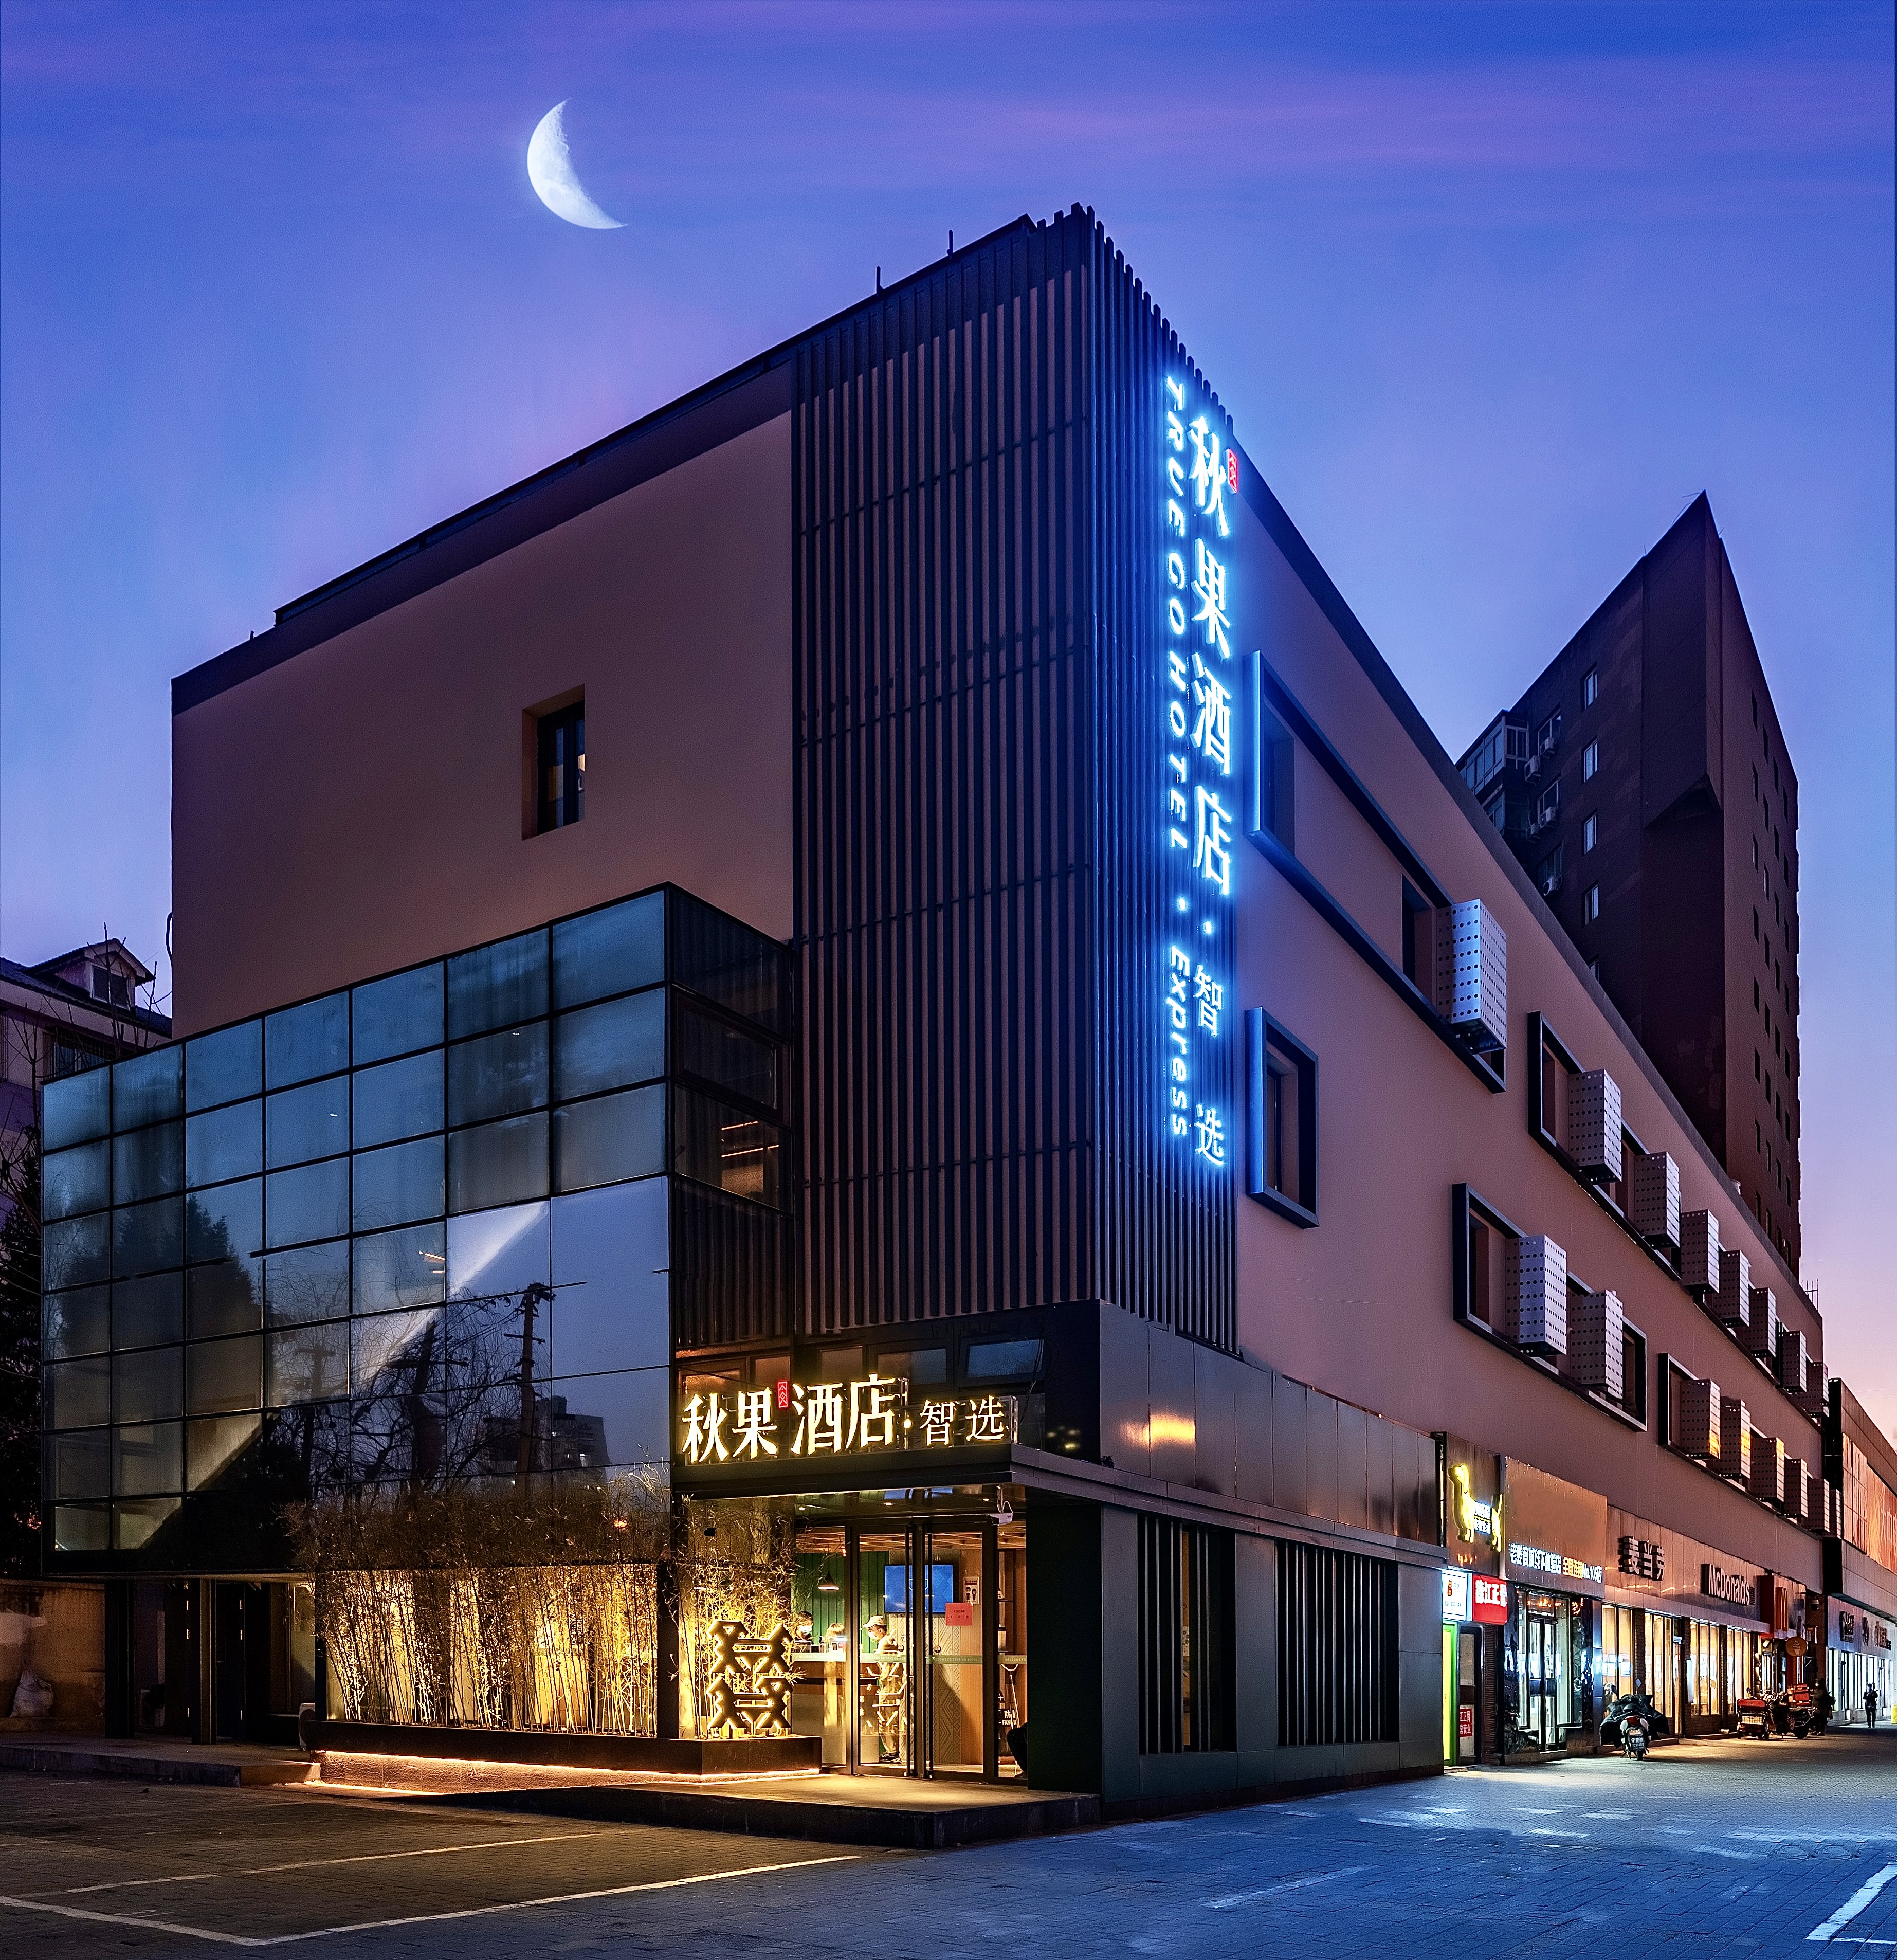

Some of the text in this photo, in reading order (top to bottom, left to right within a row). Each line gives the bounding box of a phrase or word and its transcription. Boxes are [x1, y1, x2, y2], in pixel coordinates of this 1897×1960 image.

[1166, 946, 1189, 1135] Express
[1628, 1537, 1666, 1581] 麦当劳
[1708, 1563, 1750, 1606] McDonald's
